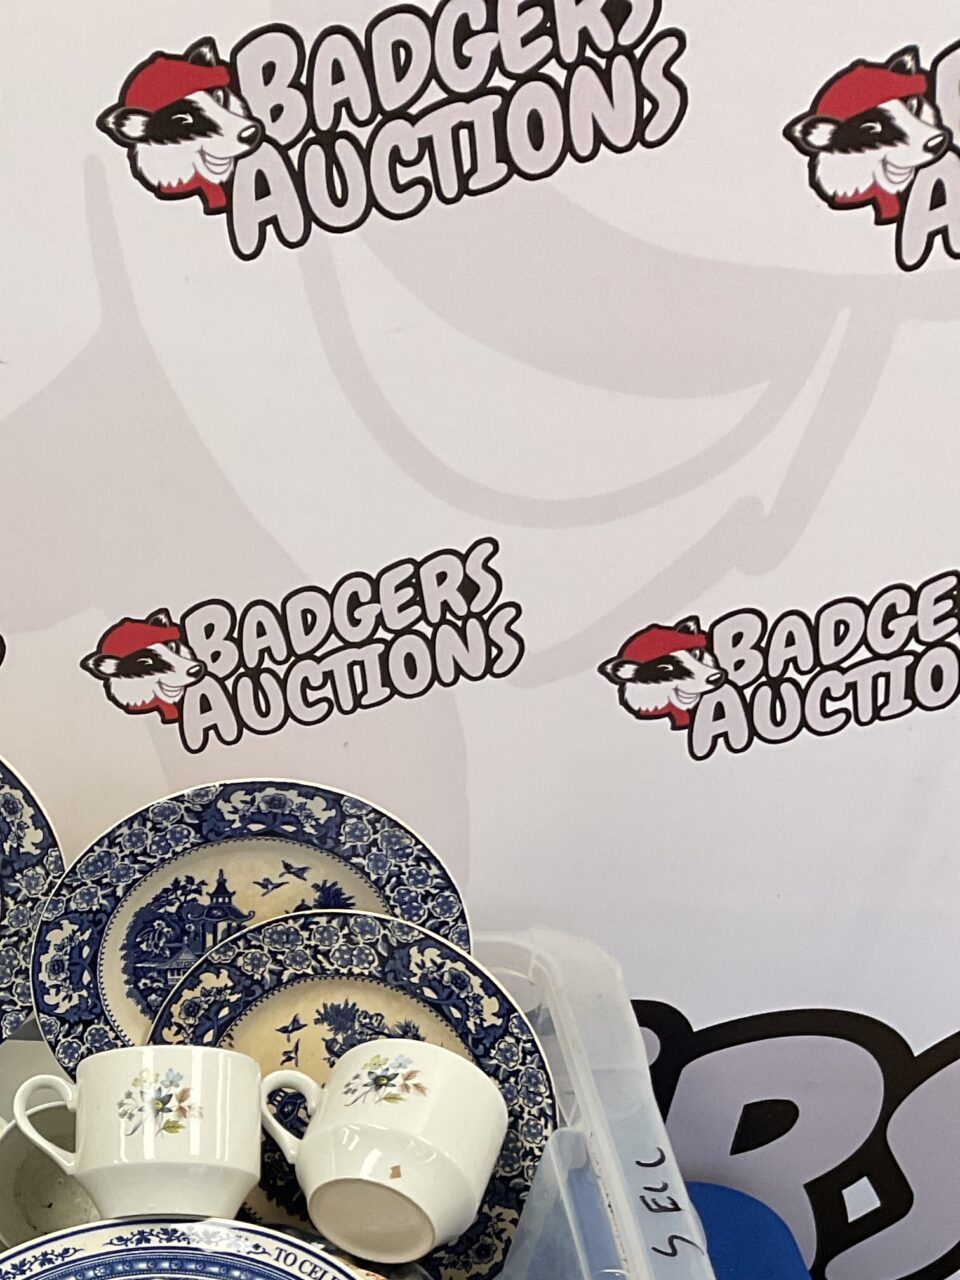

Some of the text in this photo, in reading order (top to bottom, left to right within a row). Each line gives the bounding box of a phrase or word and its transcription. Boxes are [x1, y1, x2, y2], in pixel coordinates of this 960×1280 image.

[227, 27, 688, 261] AUCTIONS
[179, 536, 502, 677] BADGERS
[709, 570, 960, 686] BADGE
[176, 600, 524, 753] AUCTIONS
[688, 641, 960, 761] AUCTIO
[275, 1247, 298, 1267] TO
